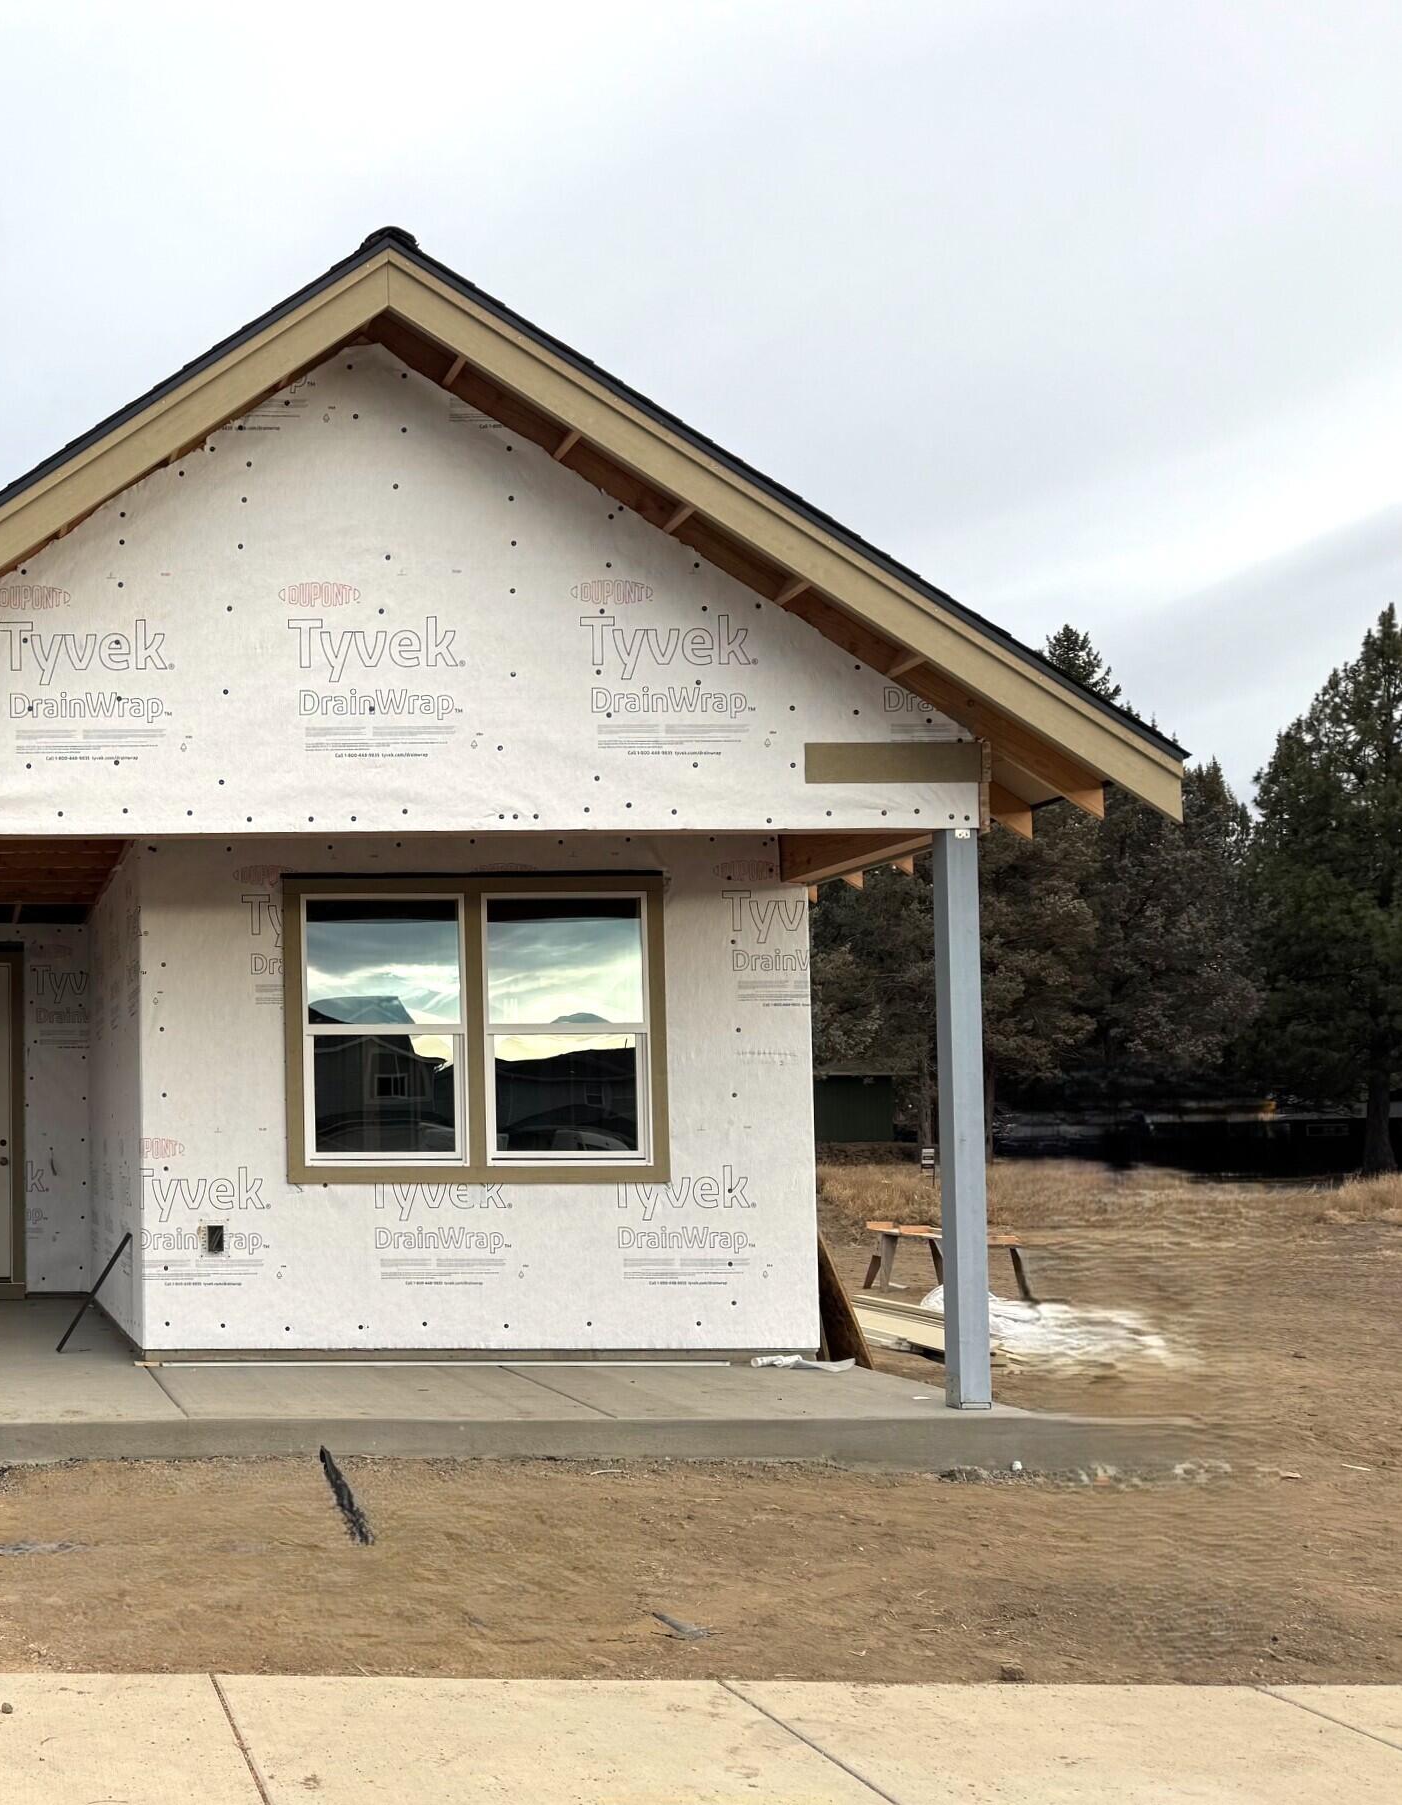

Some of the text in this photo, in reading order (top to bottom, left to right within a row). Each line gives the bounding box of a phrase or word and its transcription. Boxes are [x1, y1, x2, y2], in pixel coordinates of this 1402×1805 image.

[0, 584, 65, 611] DUPONT
[288, 582, 353, 608] DUPONT
[580, 578, 646, 605] DUPONT
[288, 616, 459, 682] Tyvek
[580, 614, 750, 681] Tyvek
[9, 691, 164, 724] DrainWrap
[299, 688, 455, 721] DrainWrap
[591, 685, 748, 719] DrainWrap
[140, 1227, 263, 1256] Drainrap
[374, 1225, 505, 1254] DrainWrap
[617, 1226, 750, 1254] DrainWrap
